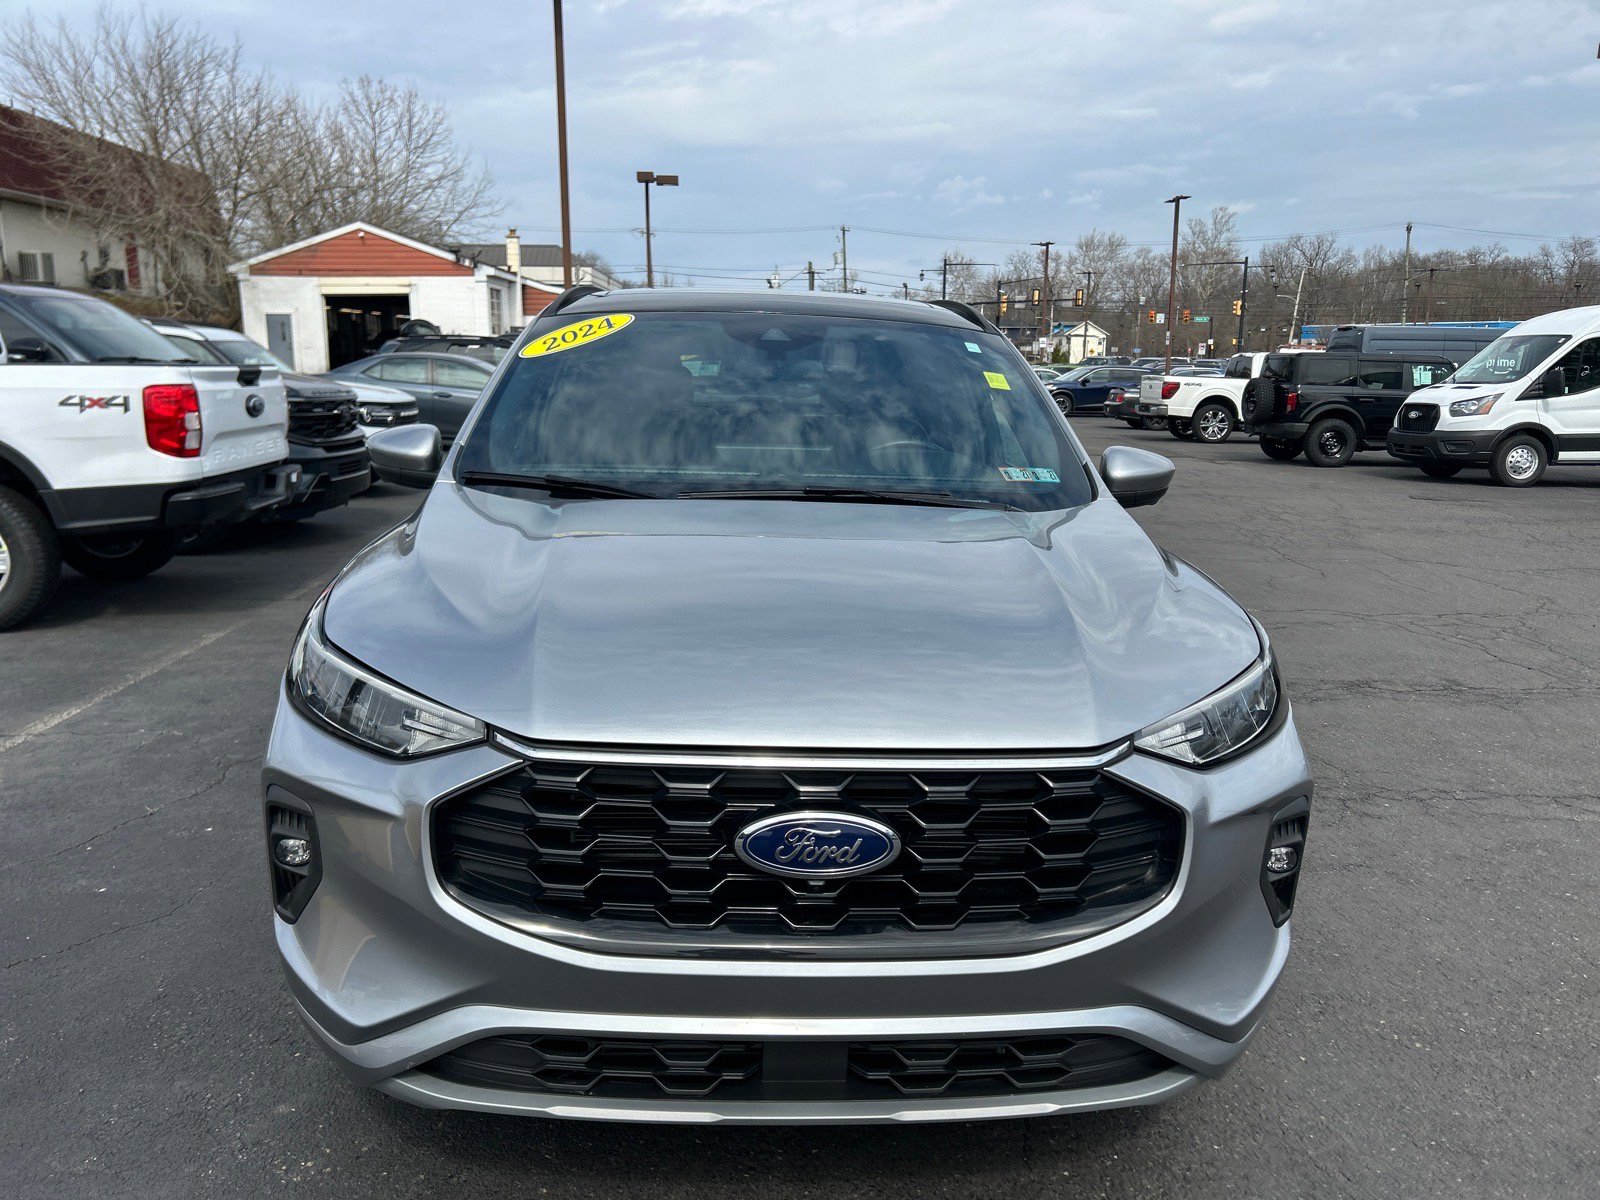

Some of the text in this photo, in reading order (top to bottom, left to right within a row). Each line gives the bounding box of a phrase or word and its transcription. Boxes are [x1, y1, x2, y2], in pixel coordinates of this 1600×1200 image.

[542, 317, 616, 352] 2024
[1486, 356, 1516, 369] prime
[214, 438, 285, 463] RANGER
[774, 827, 863, 864] Ford
